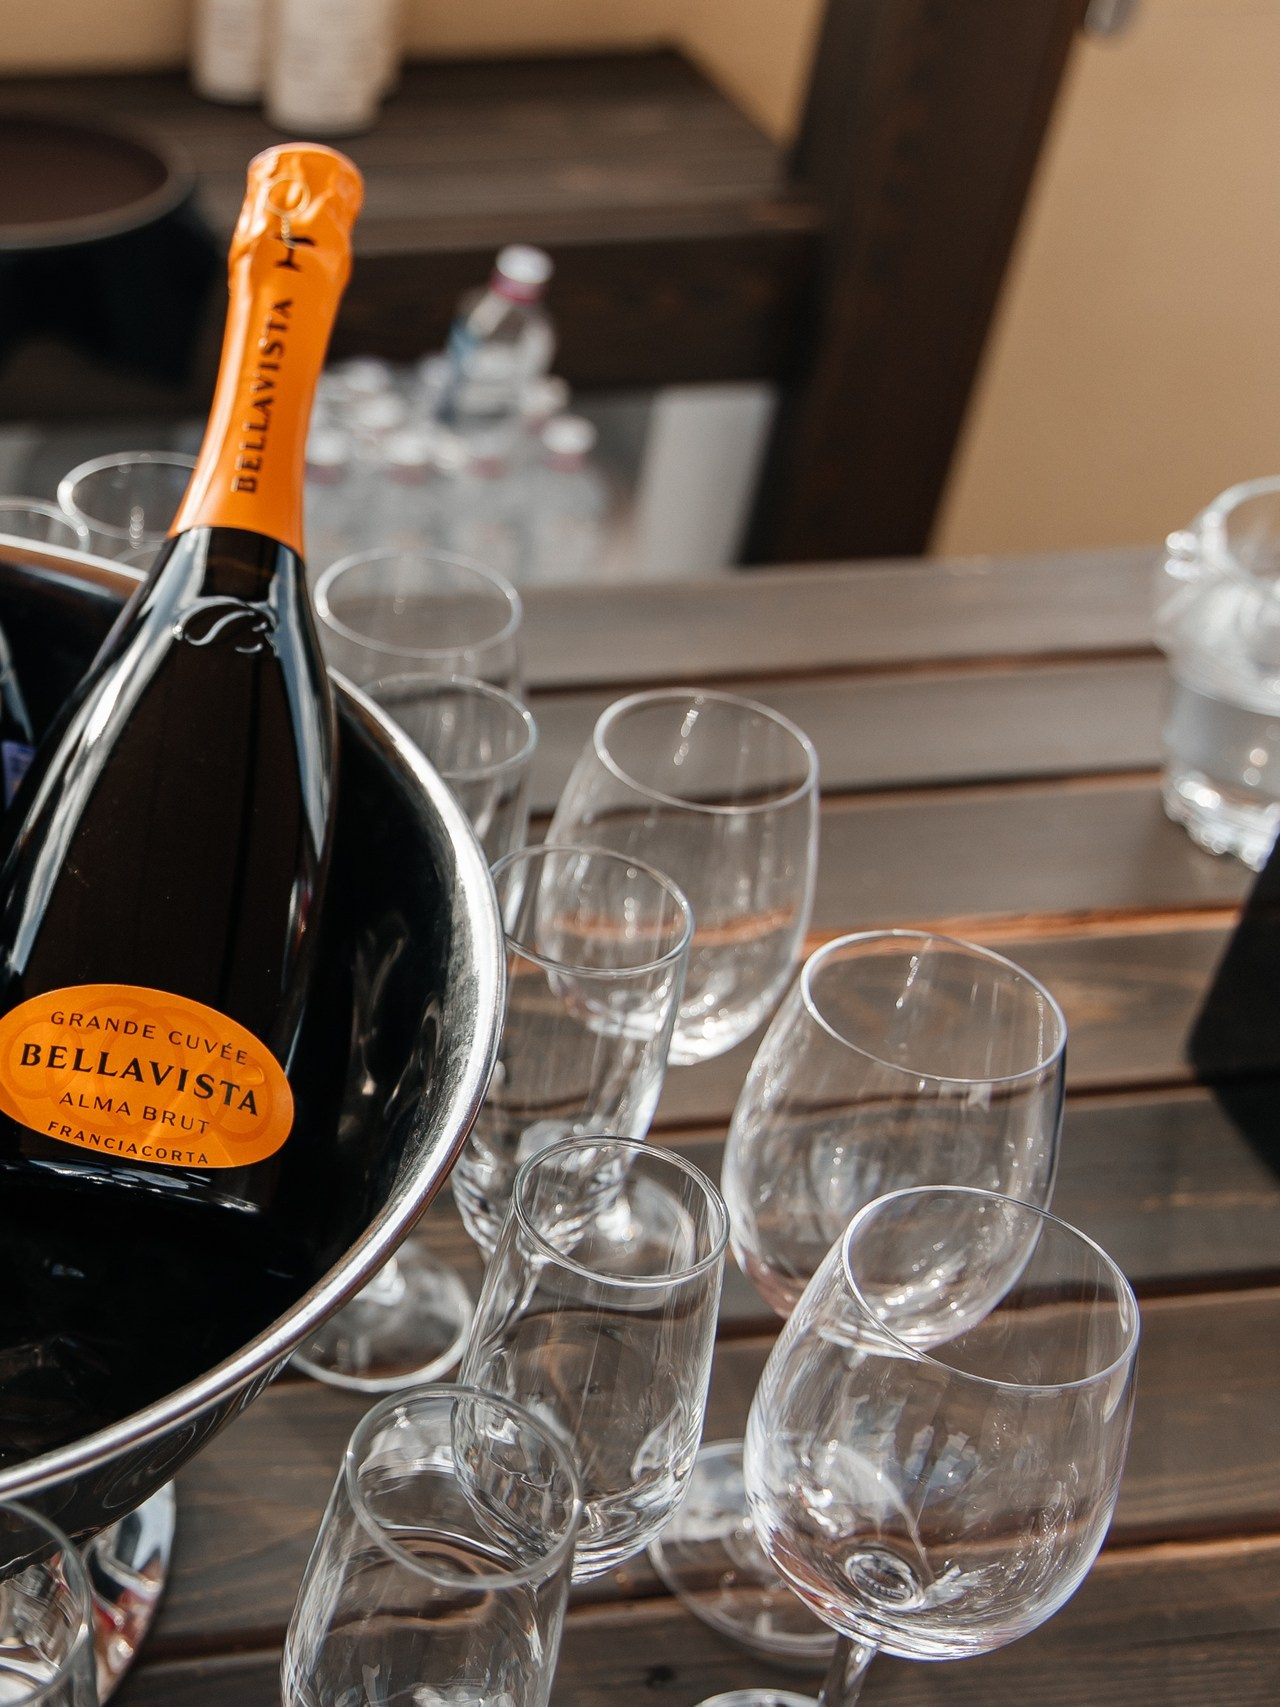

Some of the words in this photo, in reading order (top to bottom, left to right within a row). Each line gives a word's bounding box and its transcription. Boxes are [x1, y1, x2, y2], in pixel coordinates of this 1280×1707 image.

[231, 298, 293, 495] BELLAVISTA
[50, 1010, 156, 1040] GRANDE
[168, 1031, 248, 1066] CUVÉE
[20, 1043, 258, 1116] BELLAVISTA
[59, 1091, 131, 1117] ALMA
[143, 1106, 210, 1134] BRUT
[47, 1121, 209, 1165] FRANCIACORTA
